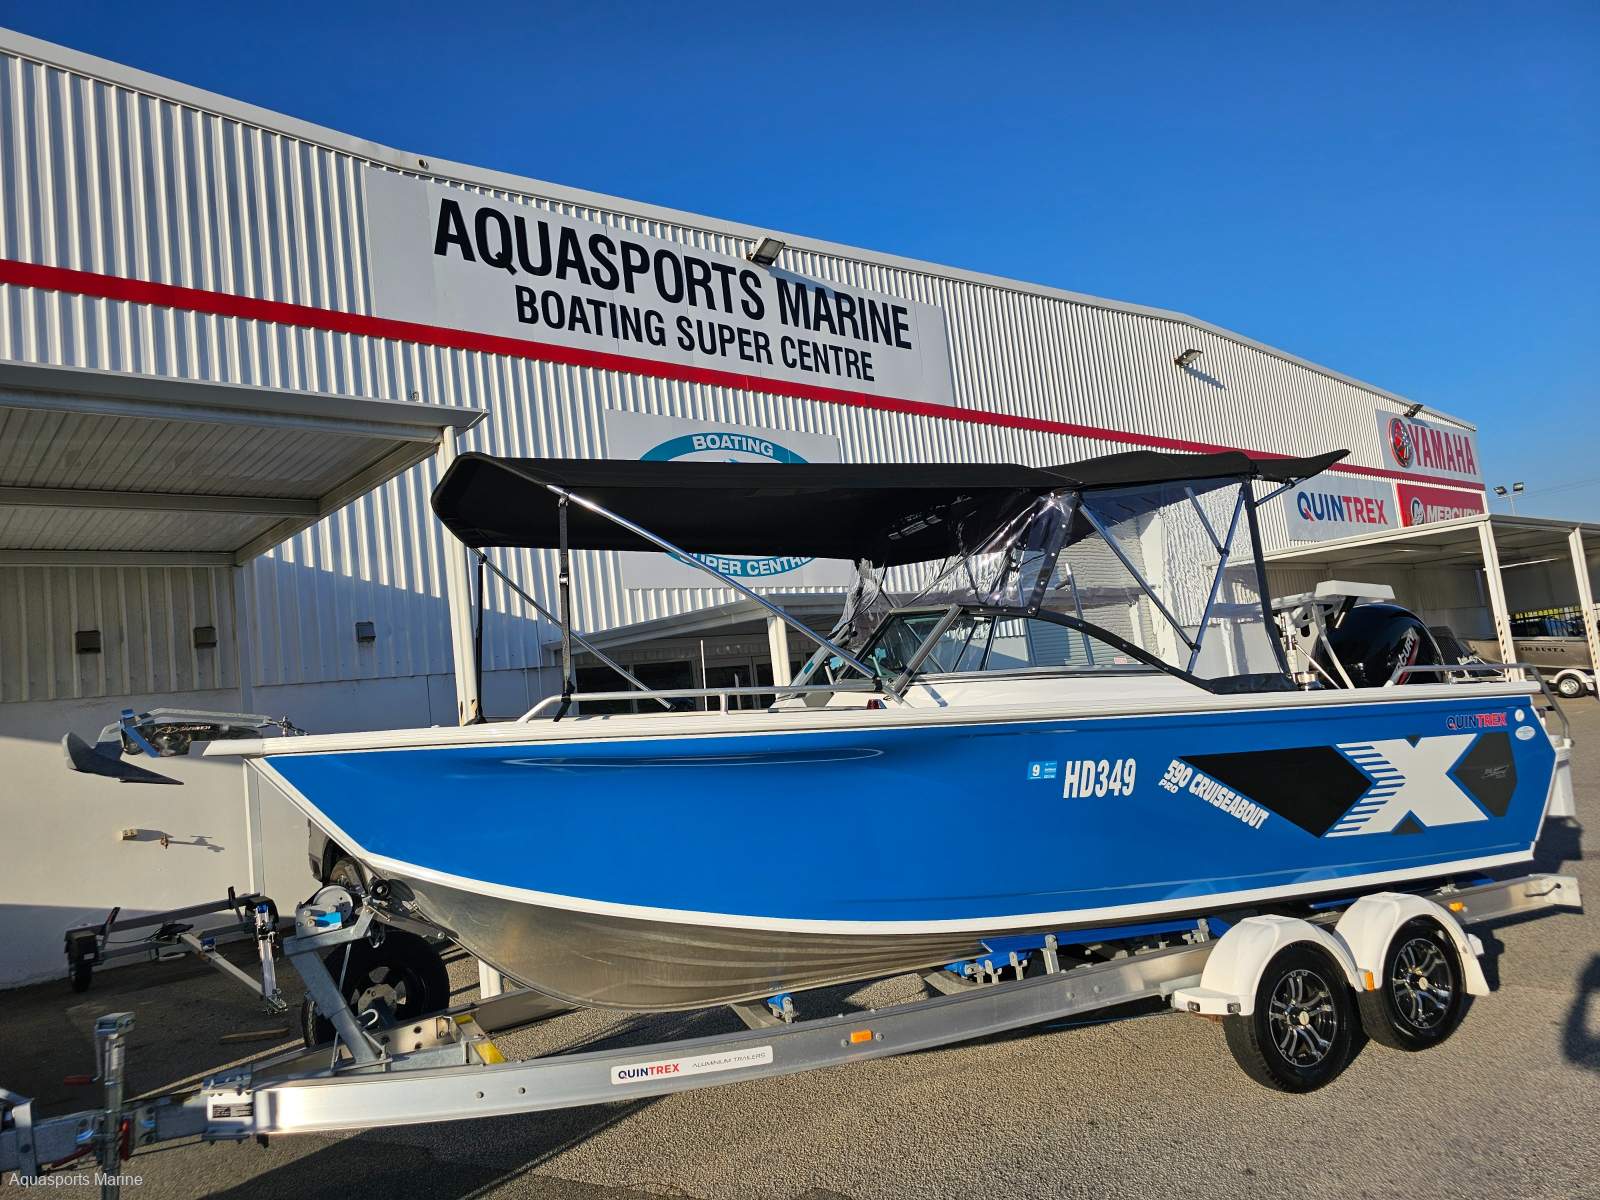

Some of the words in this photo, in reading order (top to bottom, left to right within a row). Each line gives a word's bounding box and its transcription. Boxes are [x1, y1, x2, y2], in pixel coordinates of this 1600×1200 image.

[434, 197, 764, 321] AQUASPORTS
[776, 277, 912, 350] MARINE
[515, 284, 667, 347] BOATING
[677, 315, 774, 366] SUPER
[780, 335, 875, 382] CENTRE
[692, 435, 774, 458] BOATING
[1408, 423, 1477, 476] YAMAHA
[1297, 491, 1388, 526] QUINTREX
[1446, 712, 1508, 731] QUINTREX
[1032, 764, 1041, 777] 9
[1063, 758, 1137, 799] HD349
[1158, 778, 1179, 794] PRO
[1163, 759, 1193, 788] 590
[1189, 773, 1270, 830] CRUISEABOUT
[618, 1063, 680, 1080] QUINTREX
